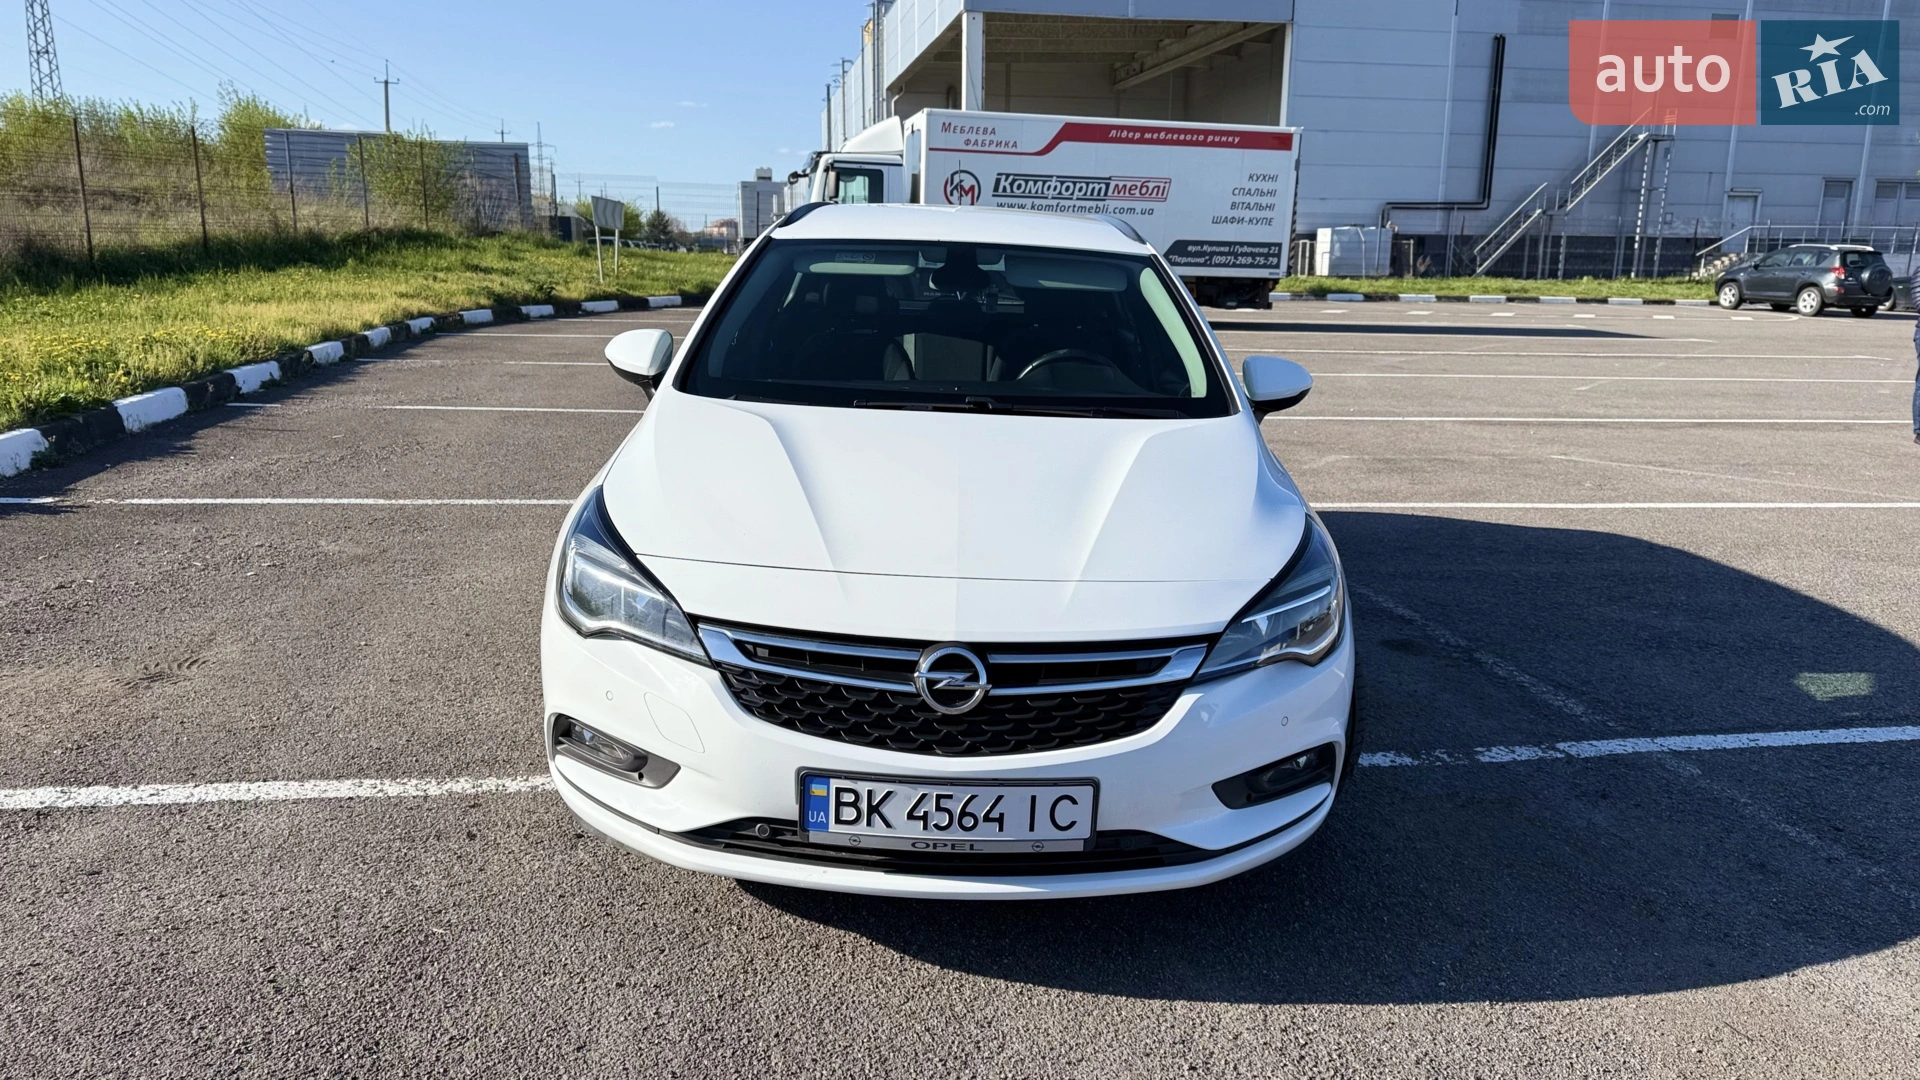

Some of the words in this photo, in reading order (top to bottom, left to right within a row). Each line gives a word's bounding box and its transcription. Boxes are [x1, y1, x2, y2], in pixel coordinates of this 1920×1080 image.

[1109, 129, 1141, 140] Лідер
[1144, 131, 1204, 142] меблевого
[1207, 134, 1241, 144] ринку
[963, 138, 1018, 149] ФАБРИКА
[1248, 173, 1279, 183] КУХНІ
[997, 174, 1107, 200] Комфорт
[1111, 179, 1168, 198] меблі
[1231, 187, 1277, 198] СПАЛЬНІ
[996, 201, 1155, 216] www.komfortmebli.com.ua
[1229, 201, 1276, 212] ВІТАЛЬНІ
[1211, 215, 1275, 226] ШАФИ-КУПЕ
[1269, 246, 1280, 254] 21
[1212, 256, 1278, 266] (097)-269-75-79
[833, 786, 897, 829] BK
[905, 792, 1005, 833] 4564
[1028, 794, 1079, 832] IC
[808, 811, 827, 824] UA
[911, 841, 984, 852] OPEL
